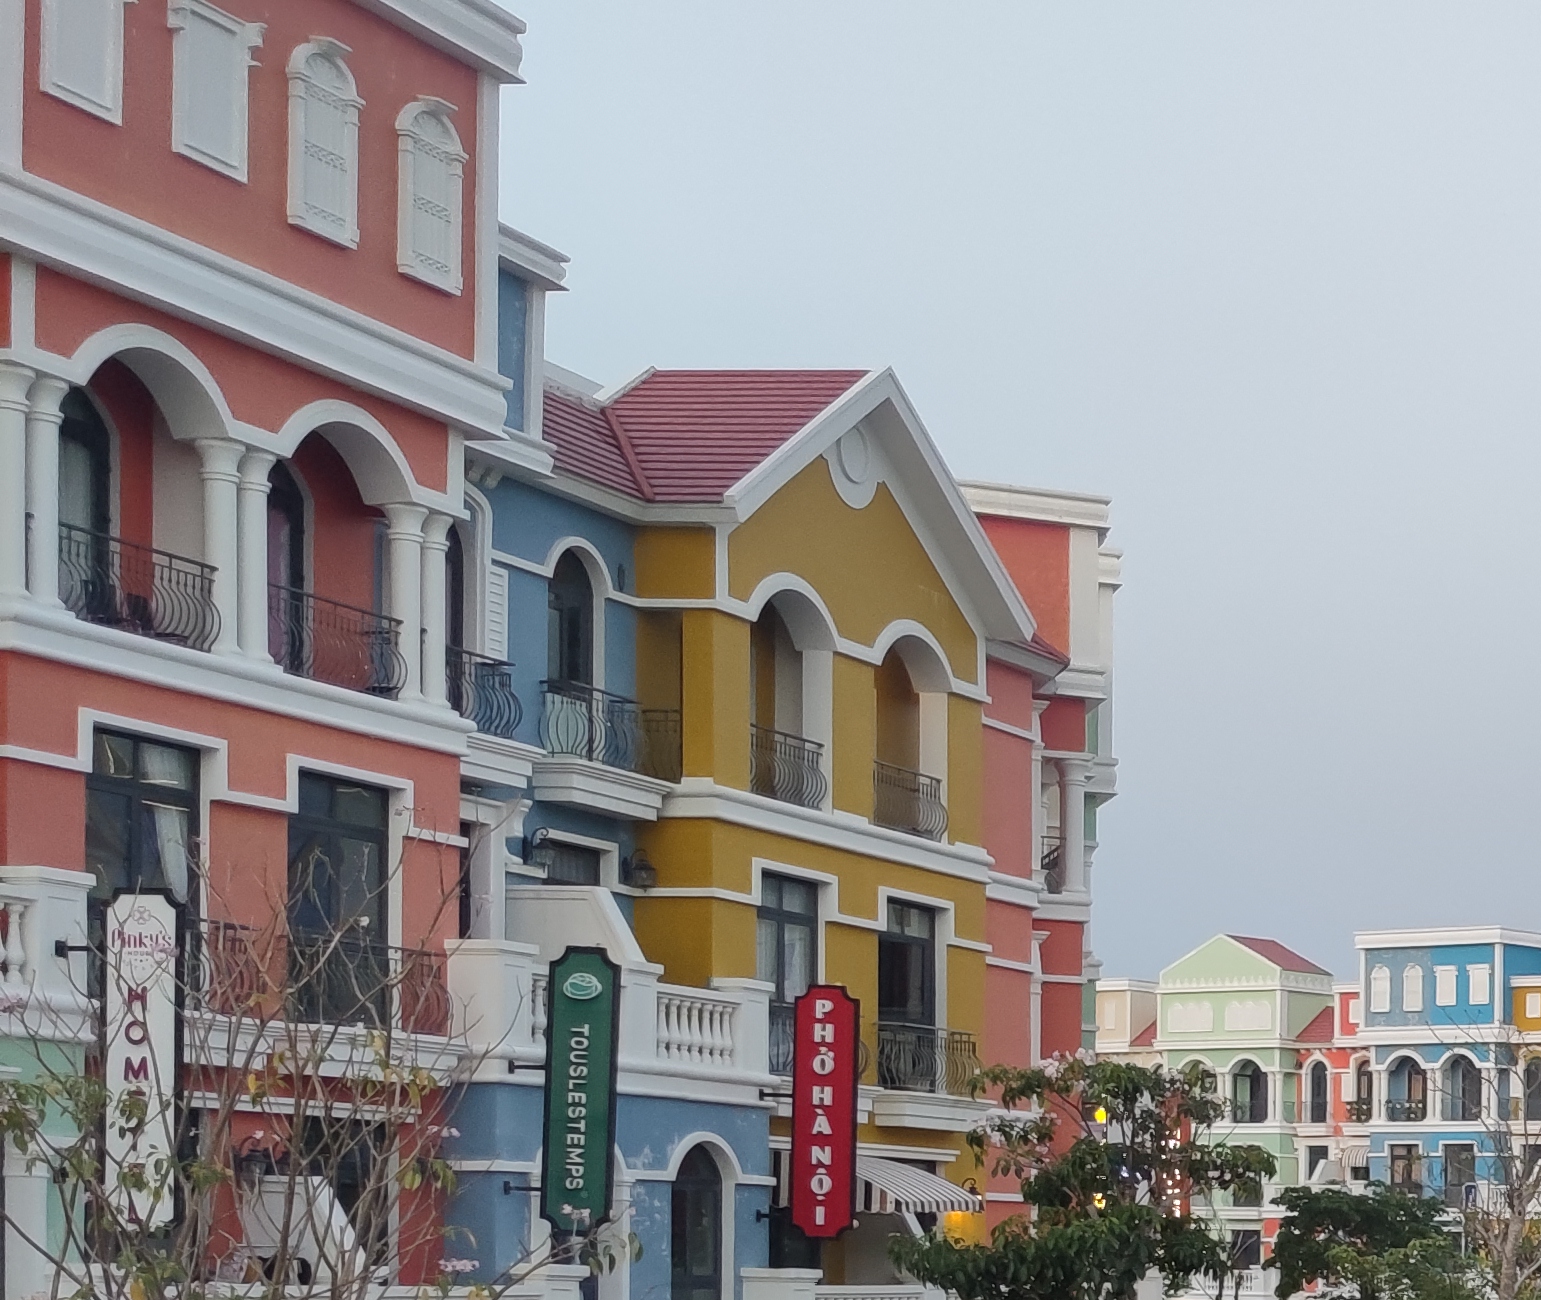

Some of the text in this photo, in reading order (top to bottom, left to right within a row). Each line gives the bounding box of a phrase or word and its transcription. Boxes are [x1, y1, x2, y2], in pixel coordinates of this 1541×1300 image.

[809, 998, 835, 1226] PHỞ HÀ NỘI
